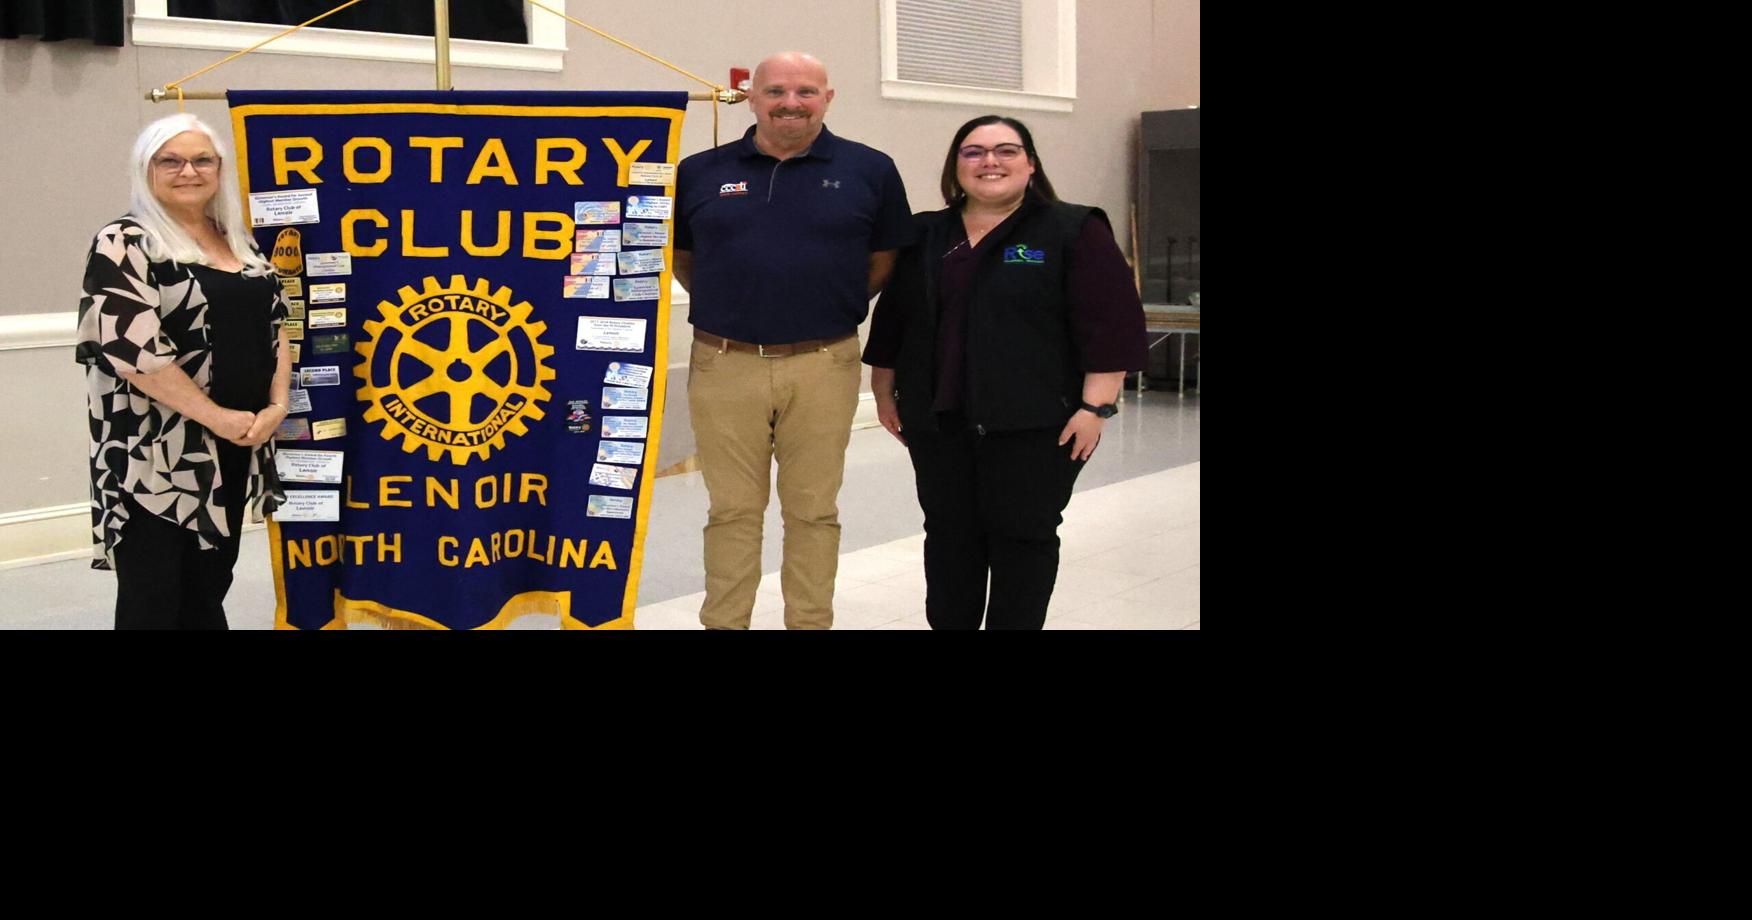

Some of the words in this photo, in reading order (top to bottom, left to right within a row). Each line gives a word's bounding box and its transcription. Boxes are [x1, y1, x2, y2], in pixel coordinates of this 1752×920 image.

[272, 137, 652, 187] ROTARY
[341, 209, 575, 259] CLUB
[408, 294, 508, 323] ROTARY
[385, 398, 525, 446] INTERNATIONAL
[347, 472, 547, 508] LENOIR
[438, 528, 617, 570] CAROLINA
